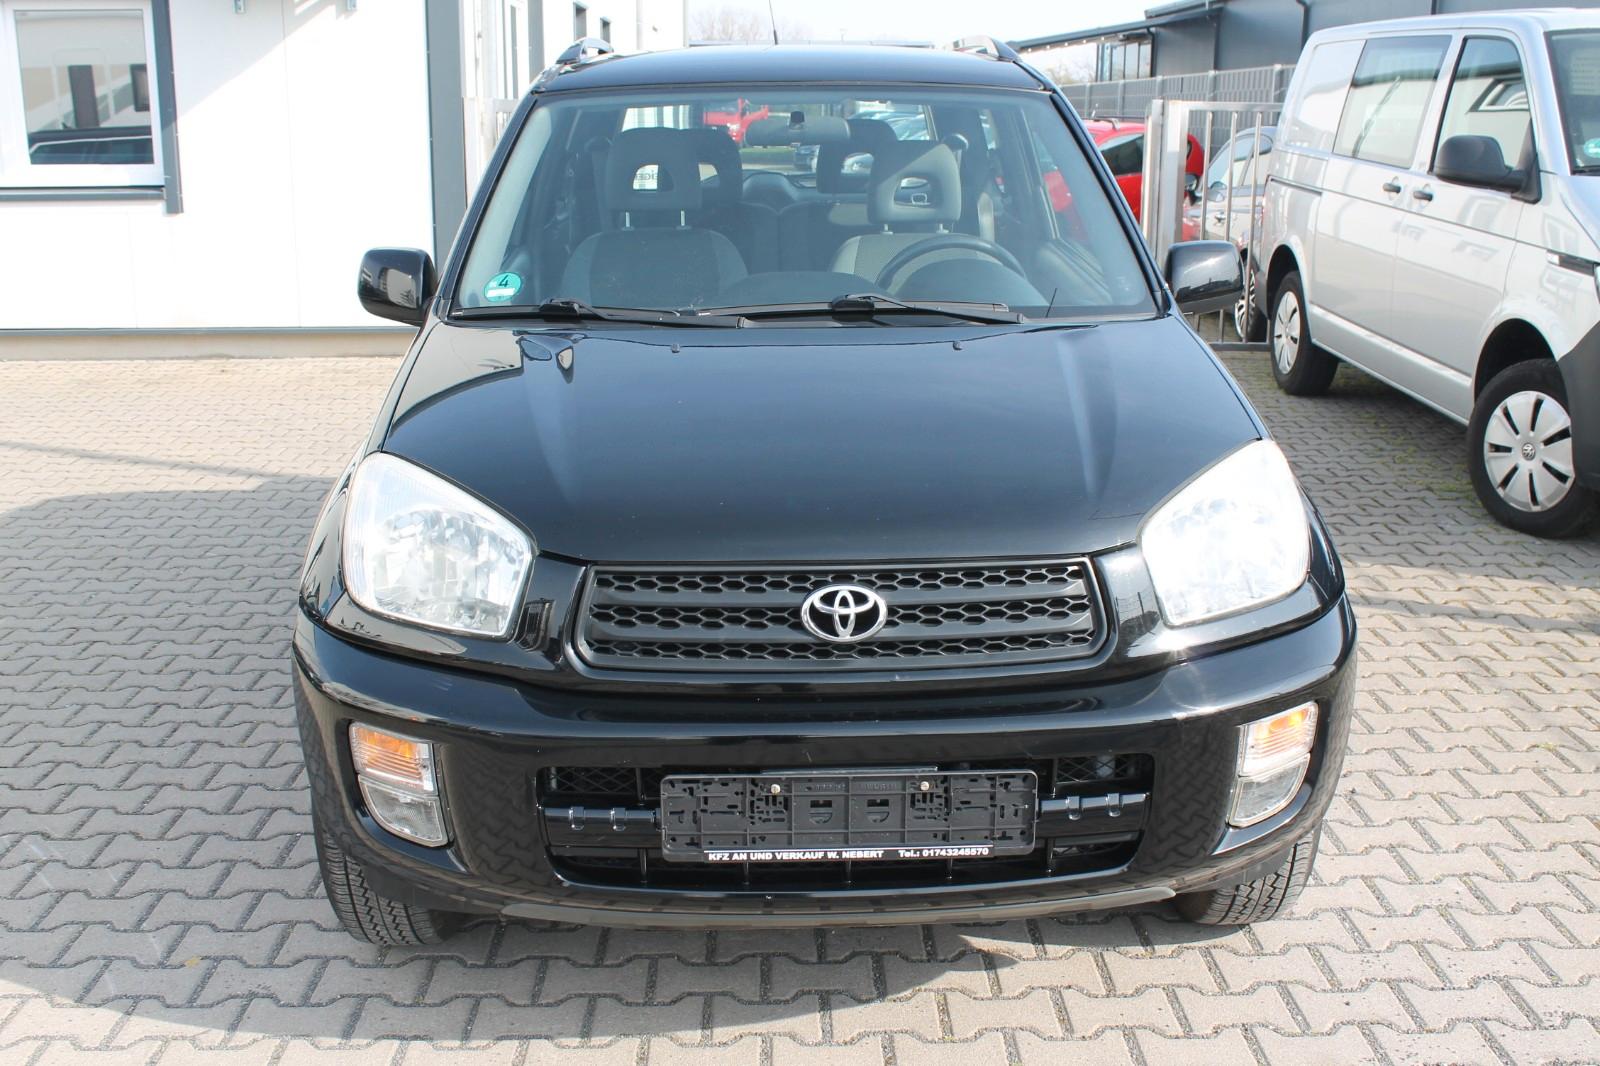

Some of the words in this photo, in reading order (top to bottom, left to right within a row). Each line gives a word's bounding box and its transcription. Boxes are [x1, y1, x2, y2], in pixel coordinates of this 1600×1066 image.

[498, 274, 509, 287] 4
[708, 852, 730, 861] KFZ
[731, 852, 747, 861] AN
[750, 852, 773, 860] UND
[775, 852, 824, 860] VERKAUF
[827, 851, 839, 859] W.
[842, 850, 884, 859] NEBERT
[899, 850, 920, 858] Tel.:
[922, 848, 989, 857] 01743245570
